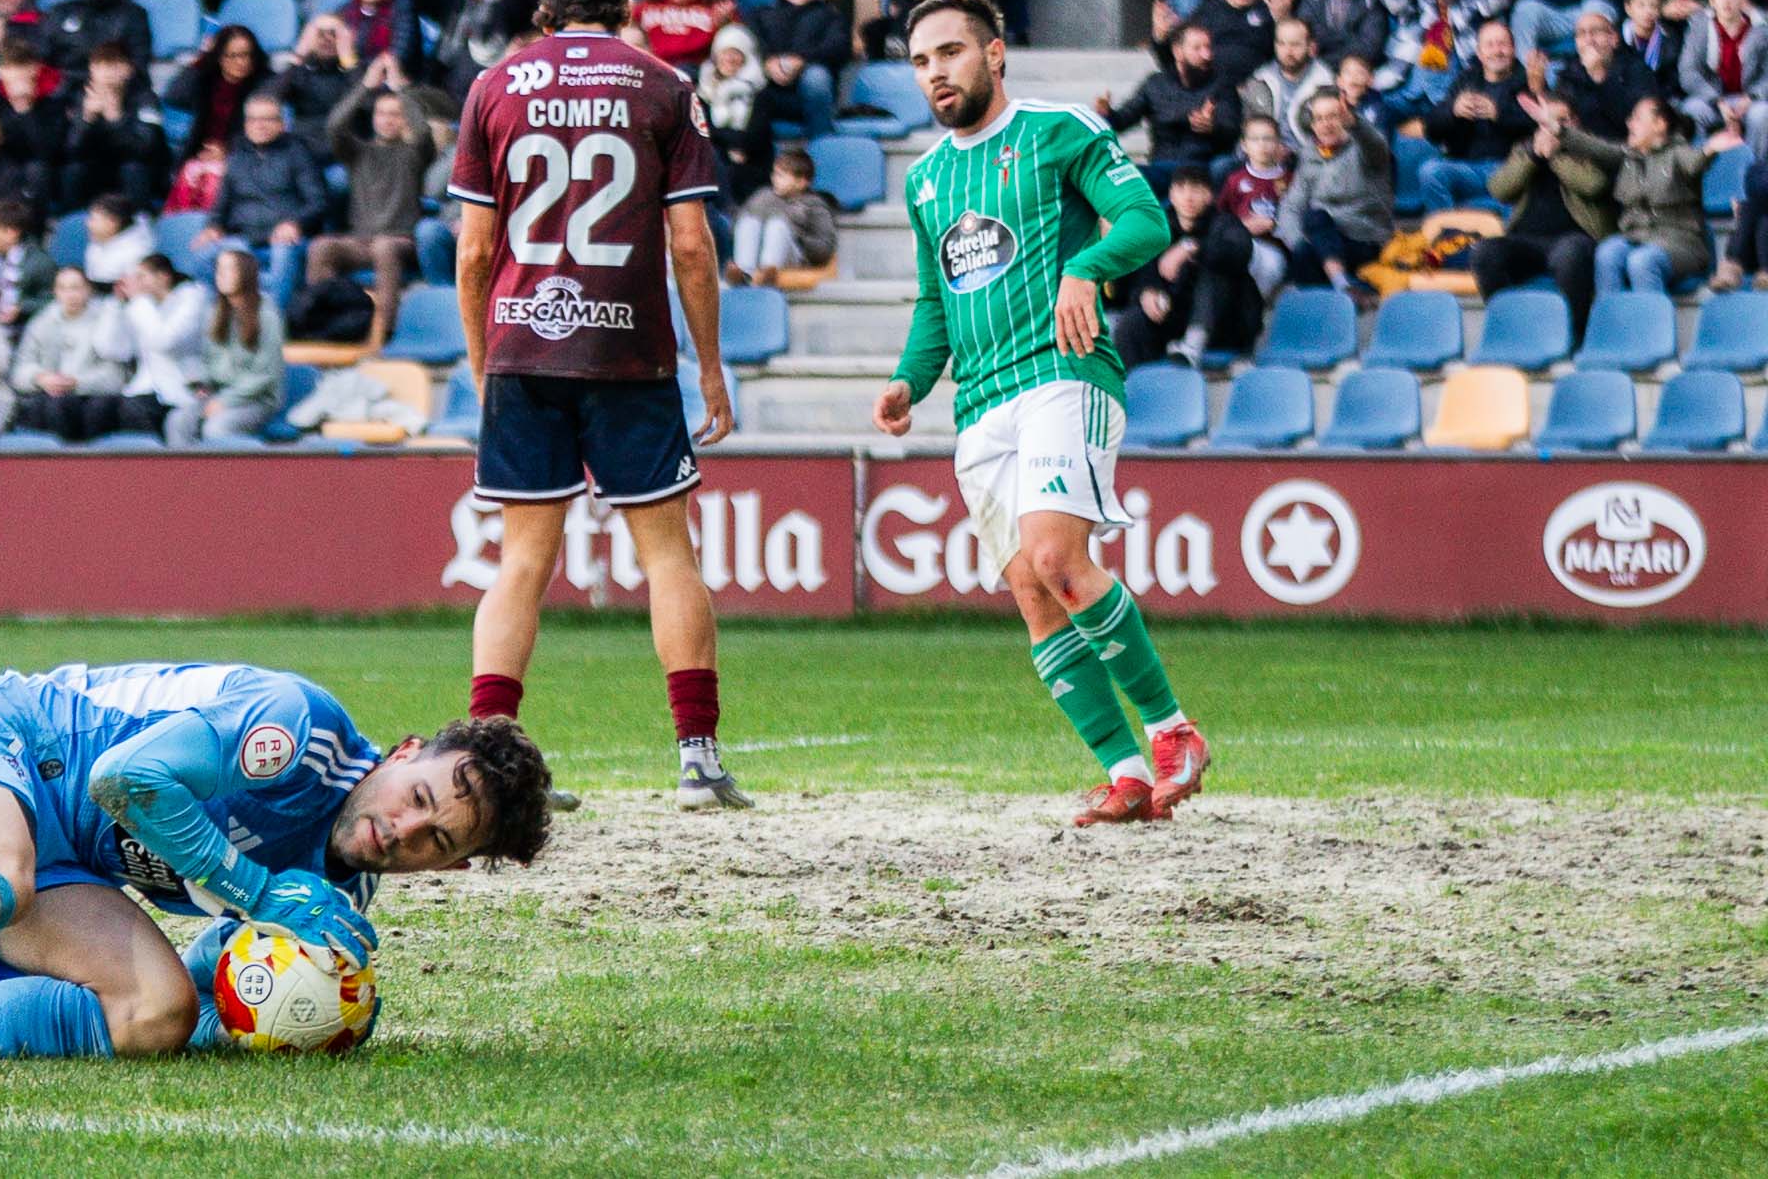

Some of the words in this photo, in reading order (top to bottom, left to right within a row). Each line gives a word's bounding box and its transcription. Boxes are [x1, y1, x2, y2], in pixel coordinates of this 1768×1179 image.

[557, 74, 643, 89] Pontevedra
[558, 63, 645, 79] Deputación
[527, 98, 629, 128] COMPA
[507, 133, 636, 266] 22
[495, 298, 634, 328] PESCAMAR
[1564, 539, 1685, 574] MAFARI
